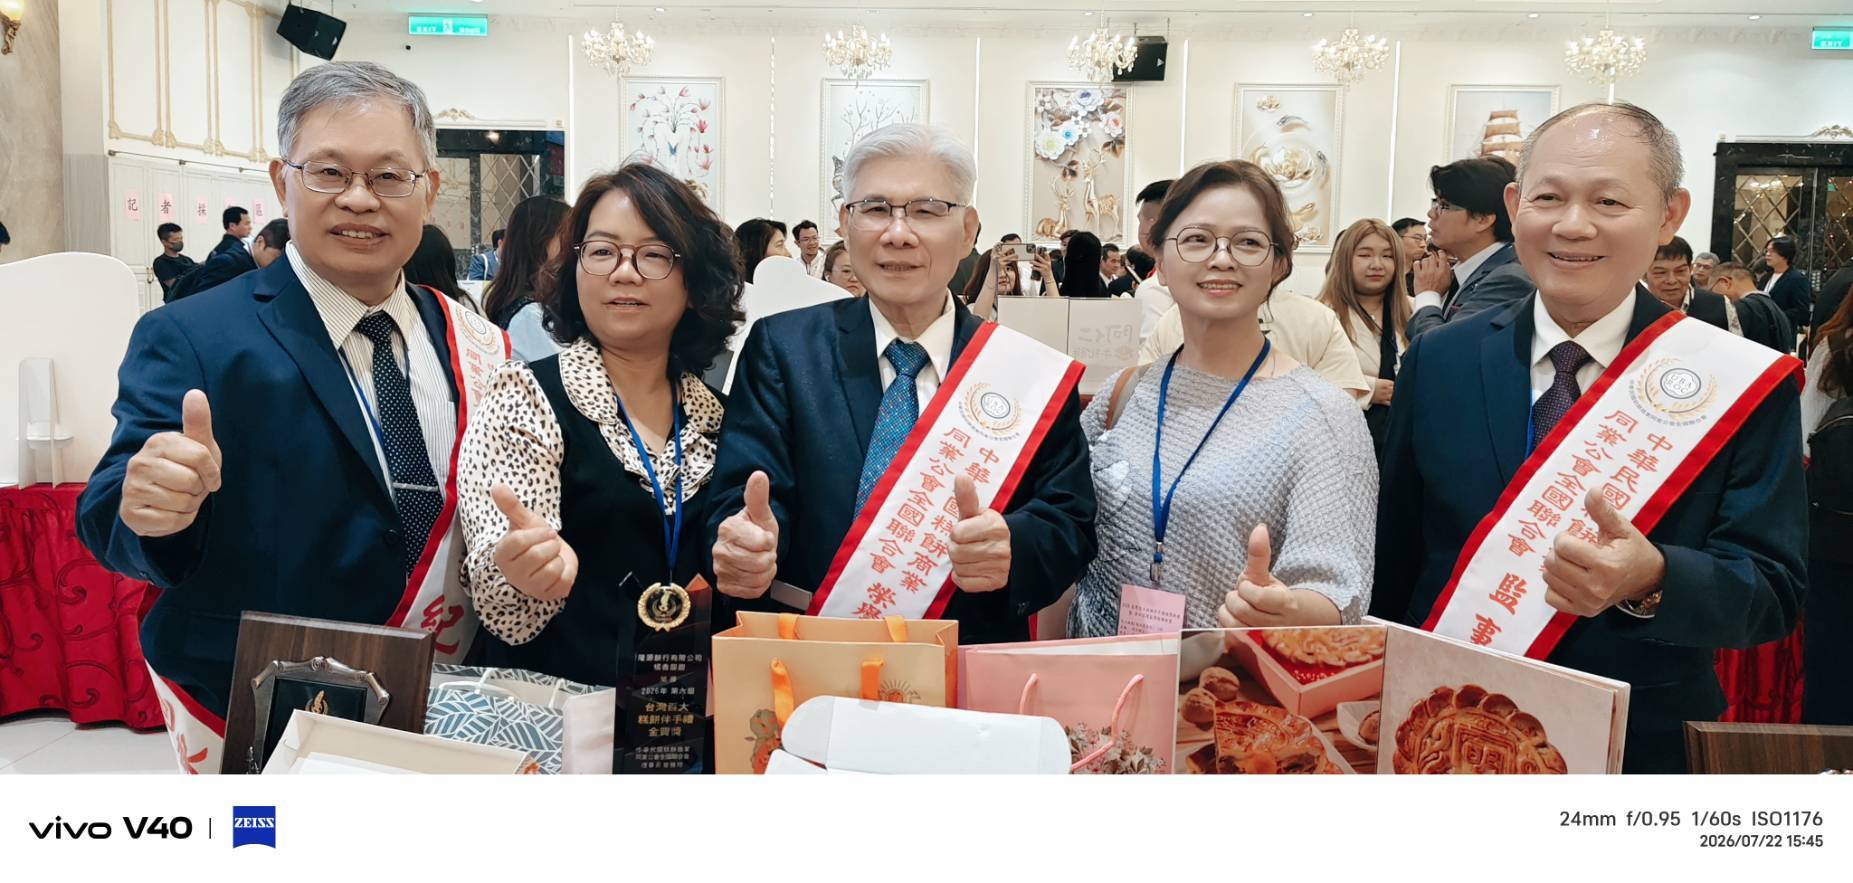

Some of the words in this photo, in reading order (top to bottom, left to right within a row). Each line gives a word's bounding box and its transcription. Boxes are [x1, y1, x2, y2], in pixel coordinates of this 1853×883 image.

[868, 427, 972, 575] 同業公會全國聯合會
[1507, 410, 1640, 557] 同業公會全國聯合會
[1470, 573, 1528, 645] 監事
